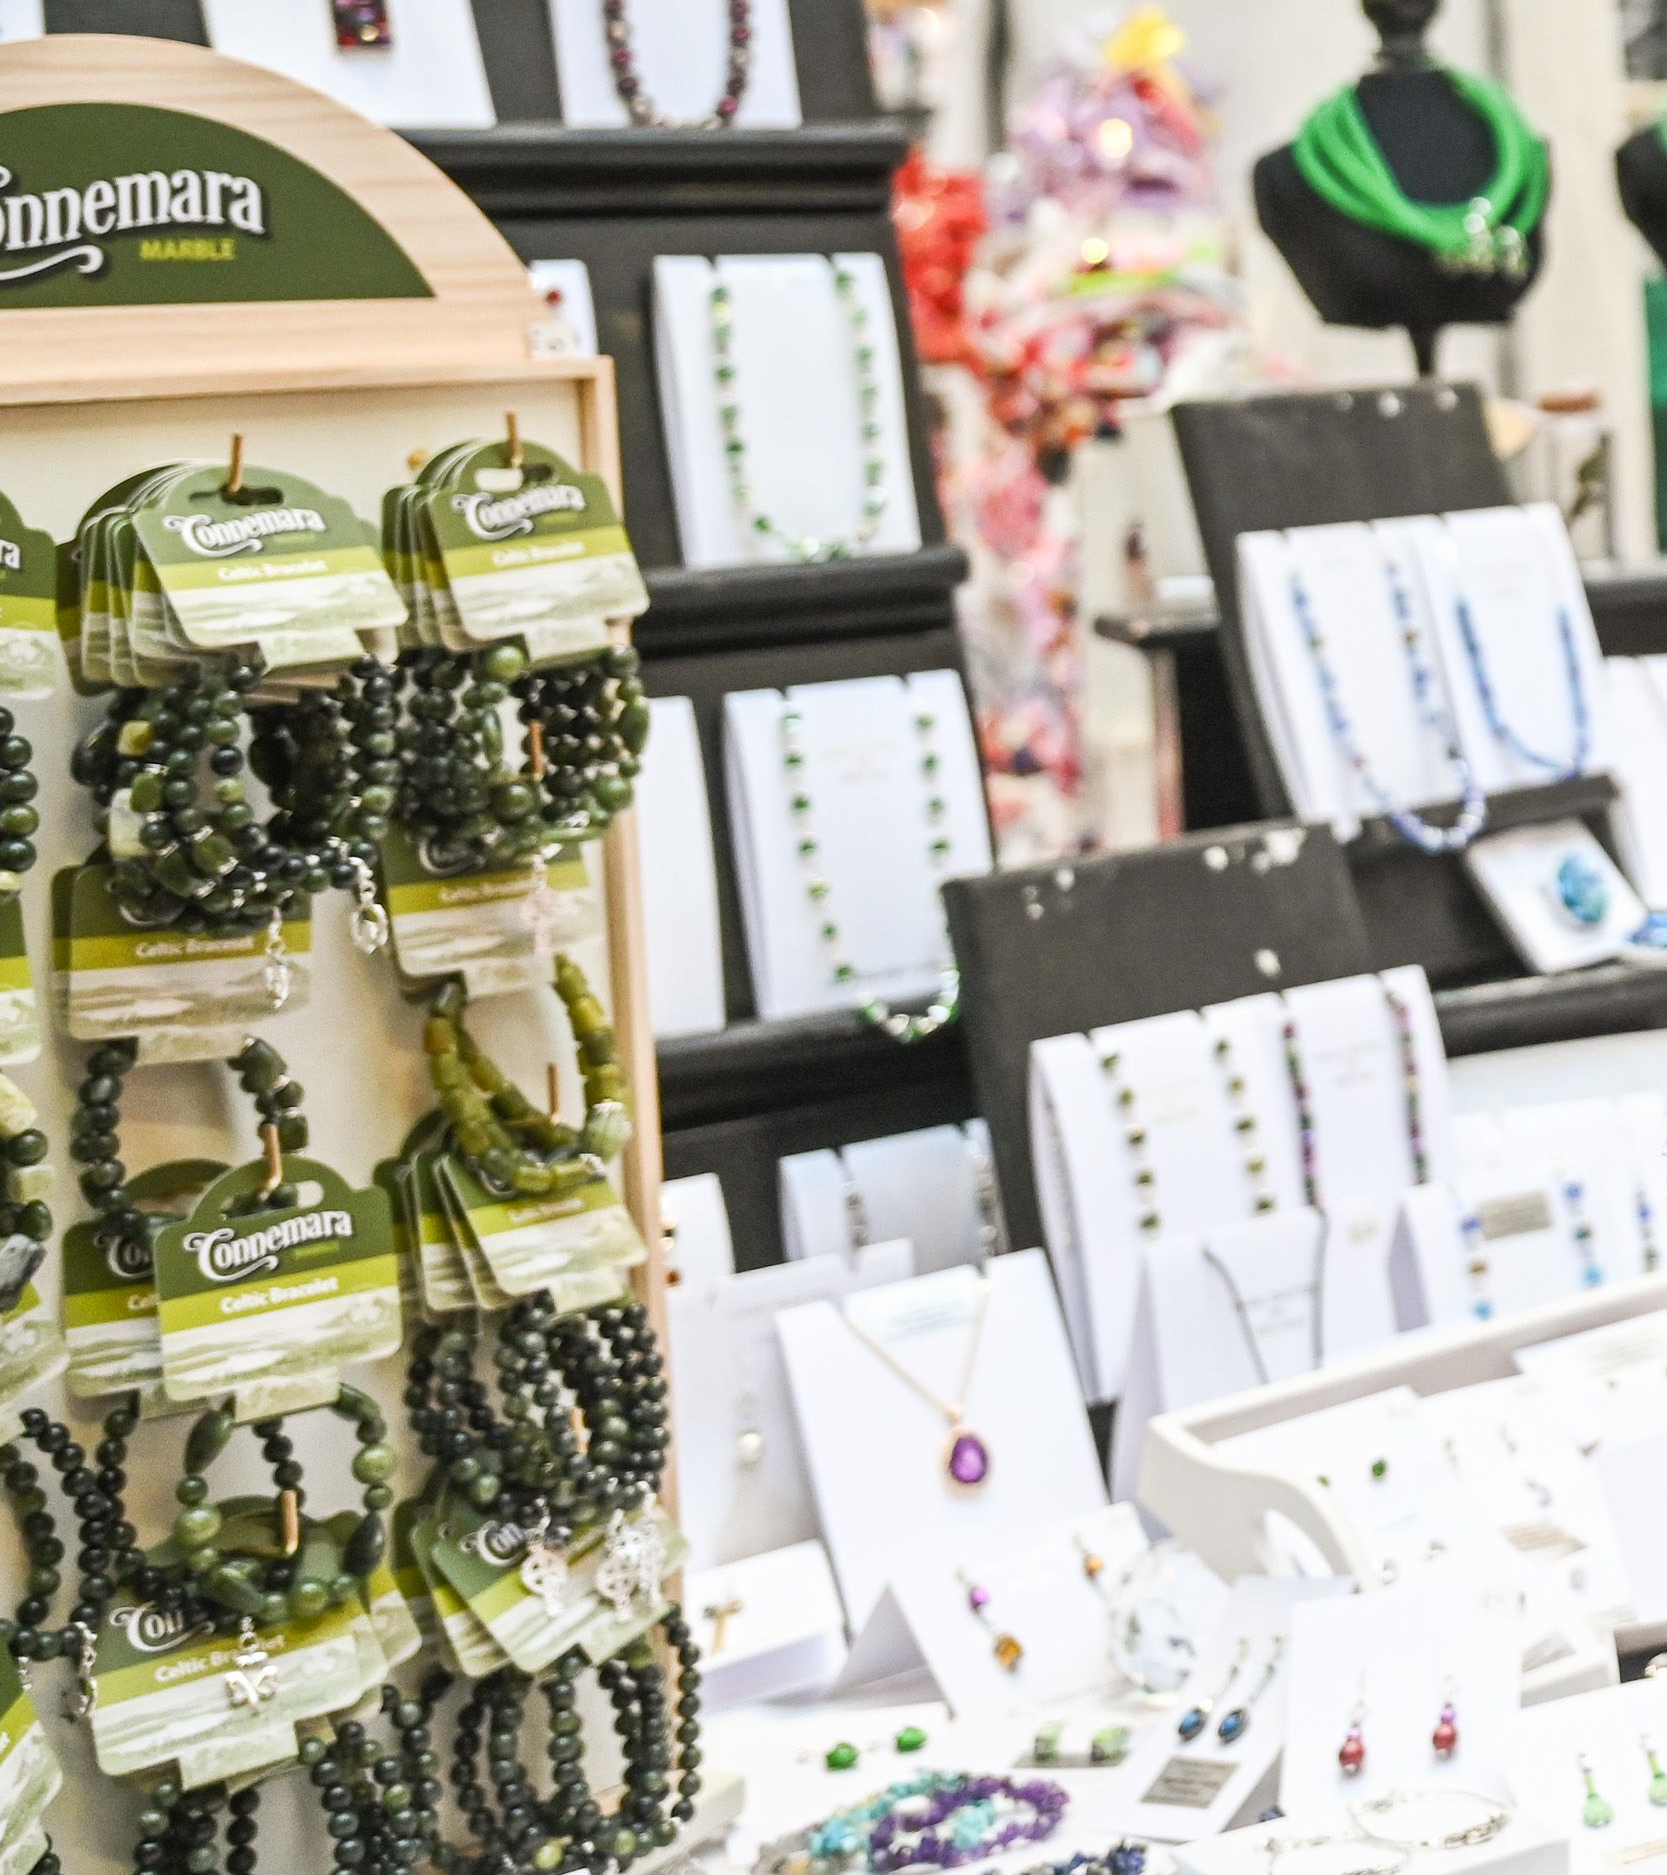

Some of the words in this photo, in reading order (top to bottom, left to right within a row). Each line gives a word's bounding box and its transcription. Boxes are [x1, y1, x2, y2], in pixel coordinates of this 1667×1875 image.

[0, 165, 266, 281] nnemara
[162, 508, 328, 558] Connemara
[183, 1210, 353, 1282] Connemara
[219, 1289, 267, 1314] Celtic
[269, 1276, 340, 1305] Bracelet
